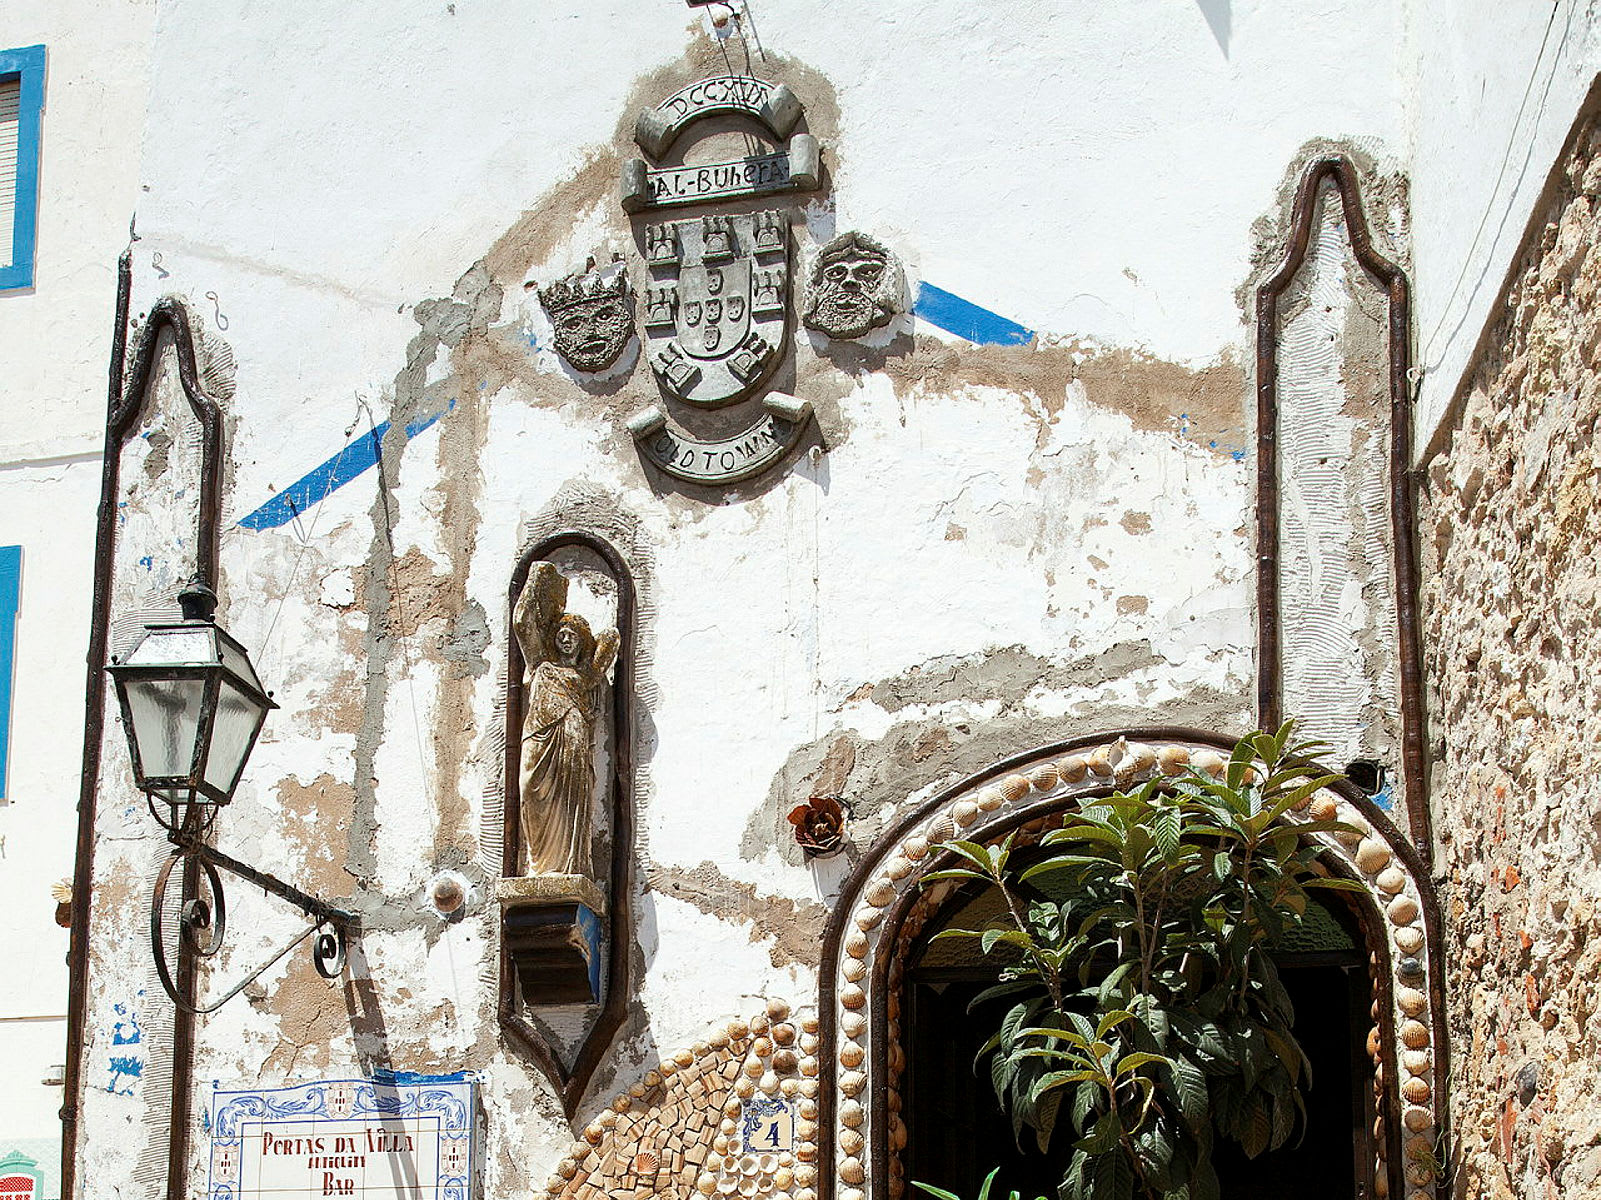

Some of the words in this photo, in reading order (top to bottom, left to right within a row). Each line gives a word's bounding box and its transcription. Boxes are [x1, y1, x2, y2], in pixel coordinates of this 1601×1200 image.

[656, 434, 695, 468] OLD
[702, 422, 777, 471] TOWN
[764, 1120, 781, 1147] 4
[322, 1171, 355, 1197] BAR
